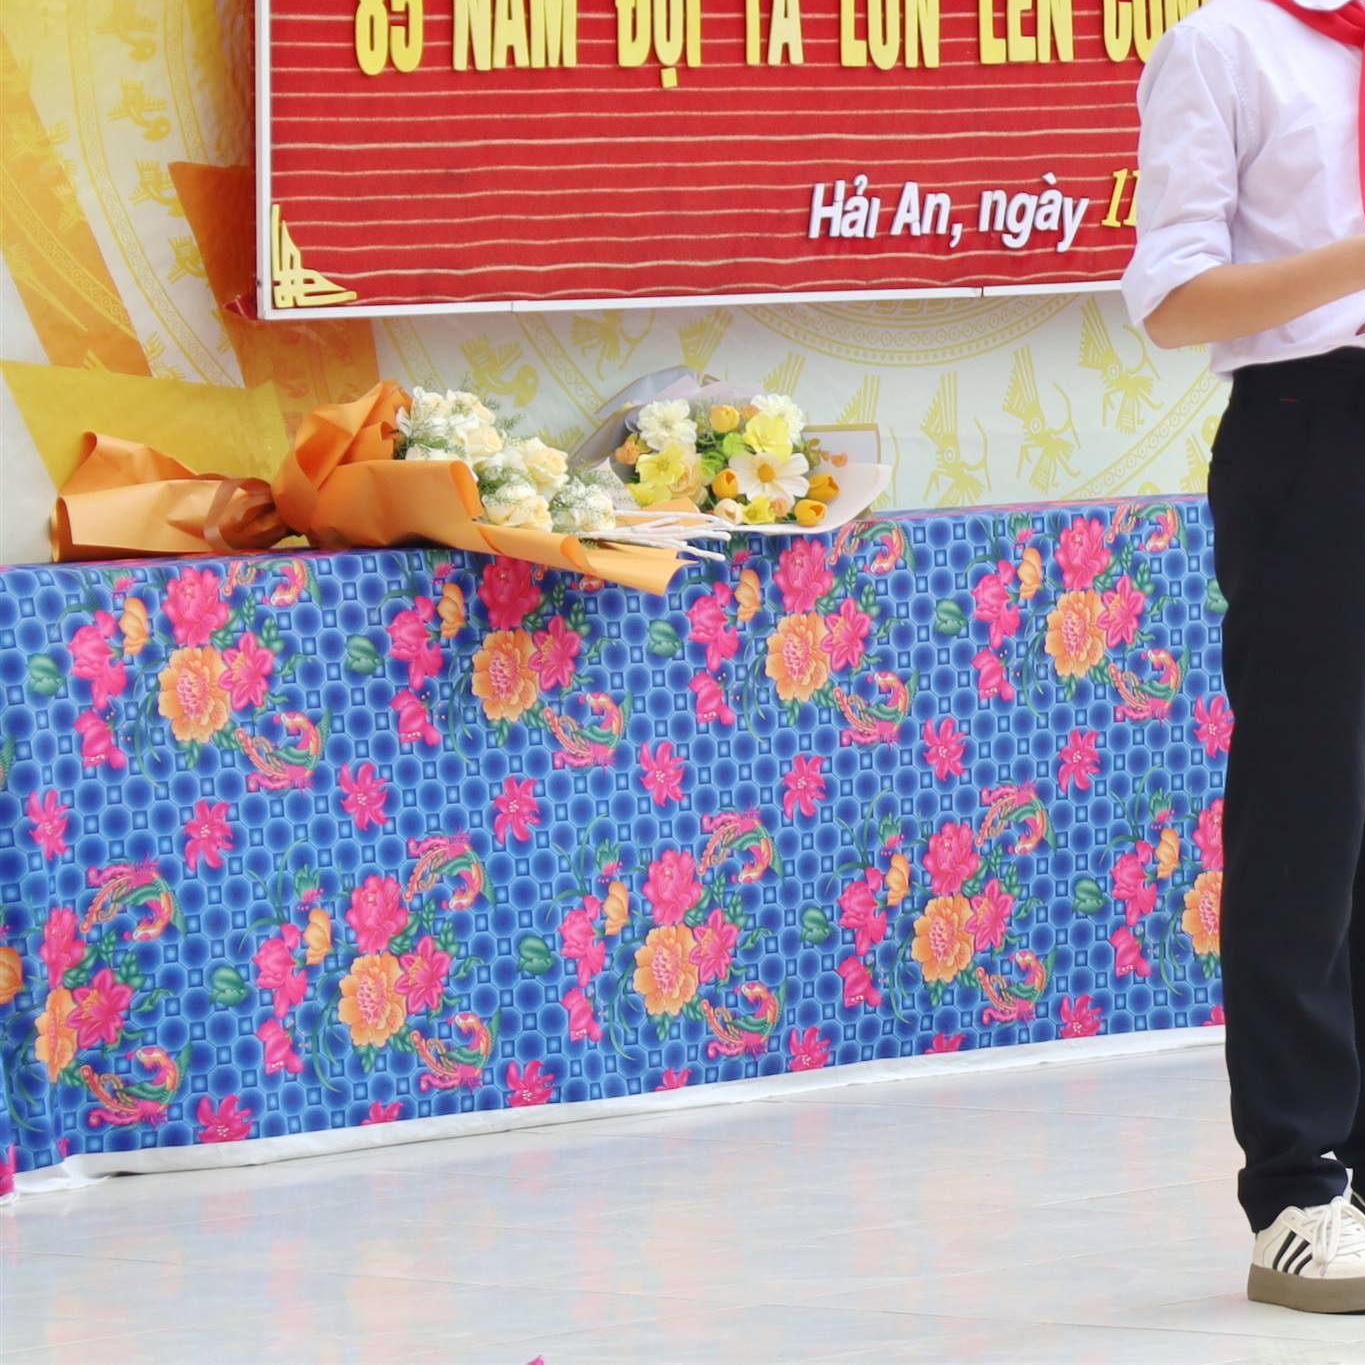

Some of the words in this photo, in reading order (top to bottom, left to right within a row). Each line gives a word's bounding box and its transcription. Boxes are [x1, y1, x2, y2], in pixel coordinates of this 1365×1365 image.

[808, 173, 881, 238] Hải
[890, 181, 963, 249] An,
[978, 171, 1090, 253] ngày
